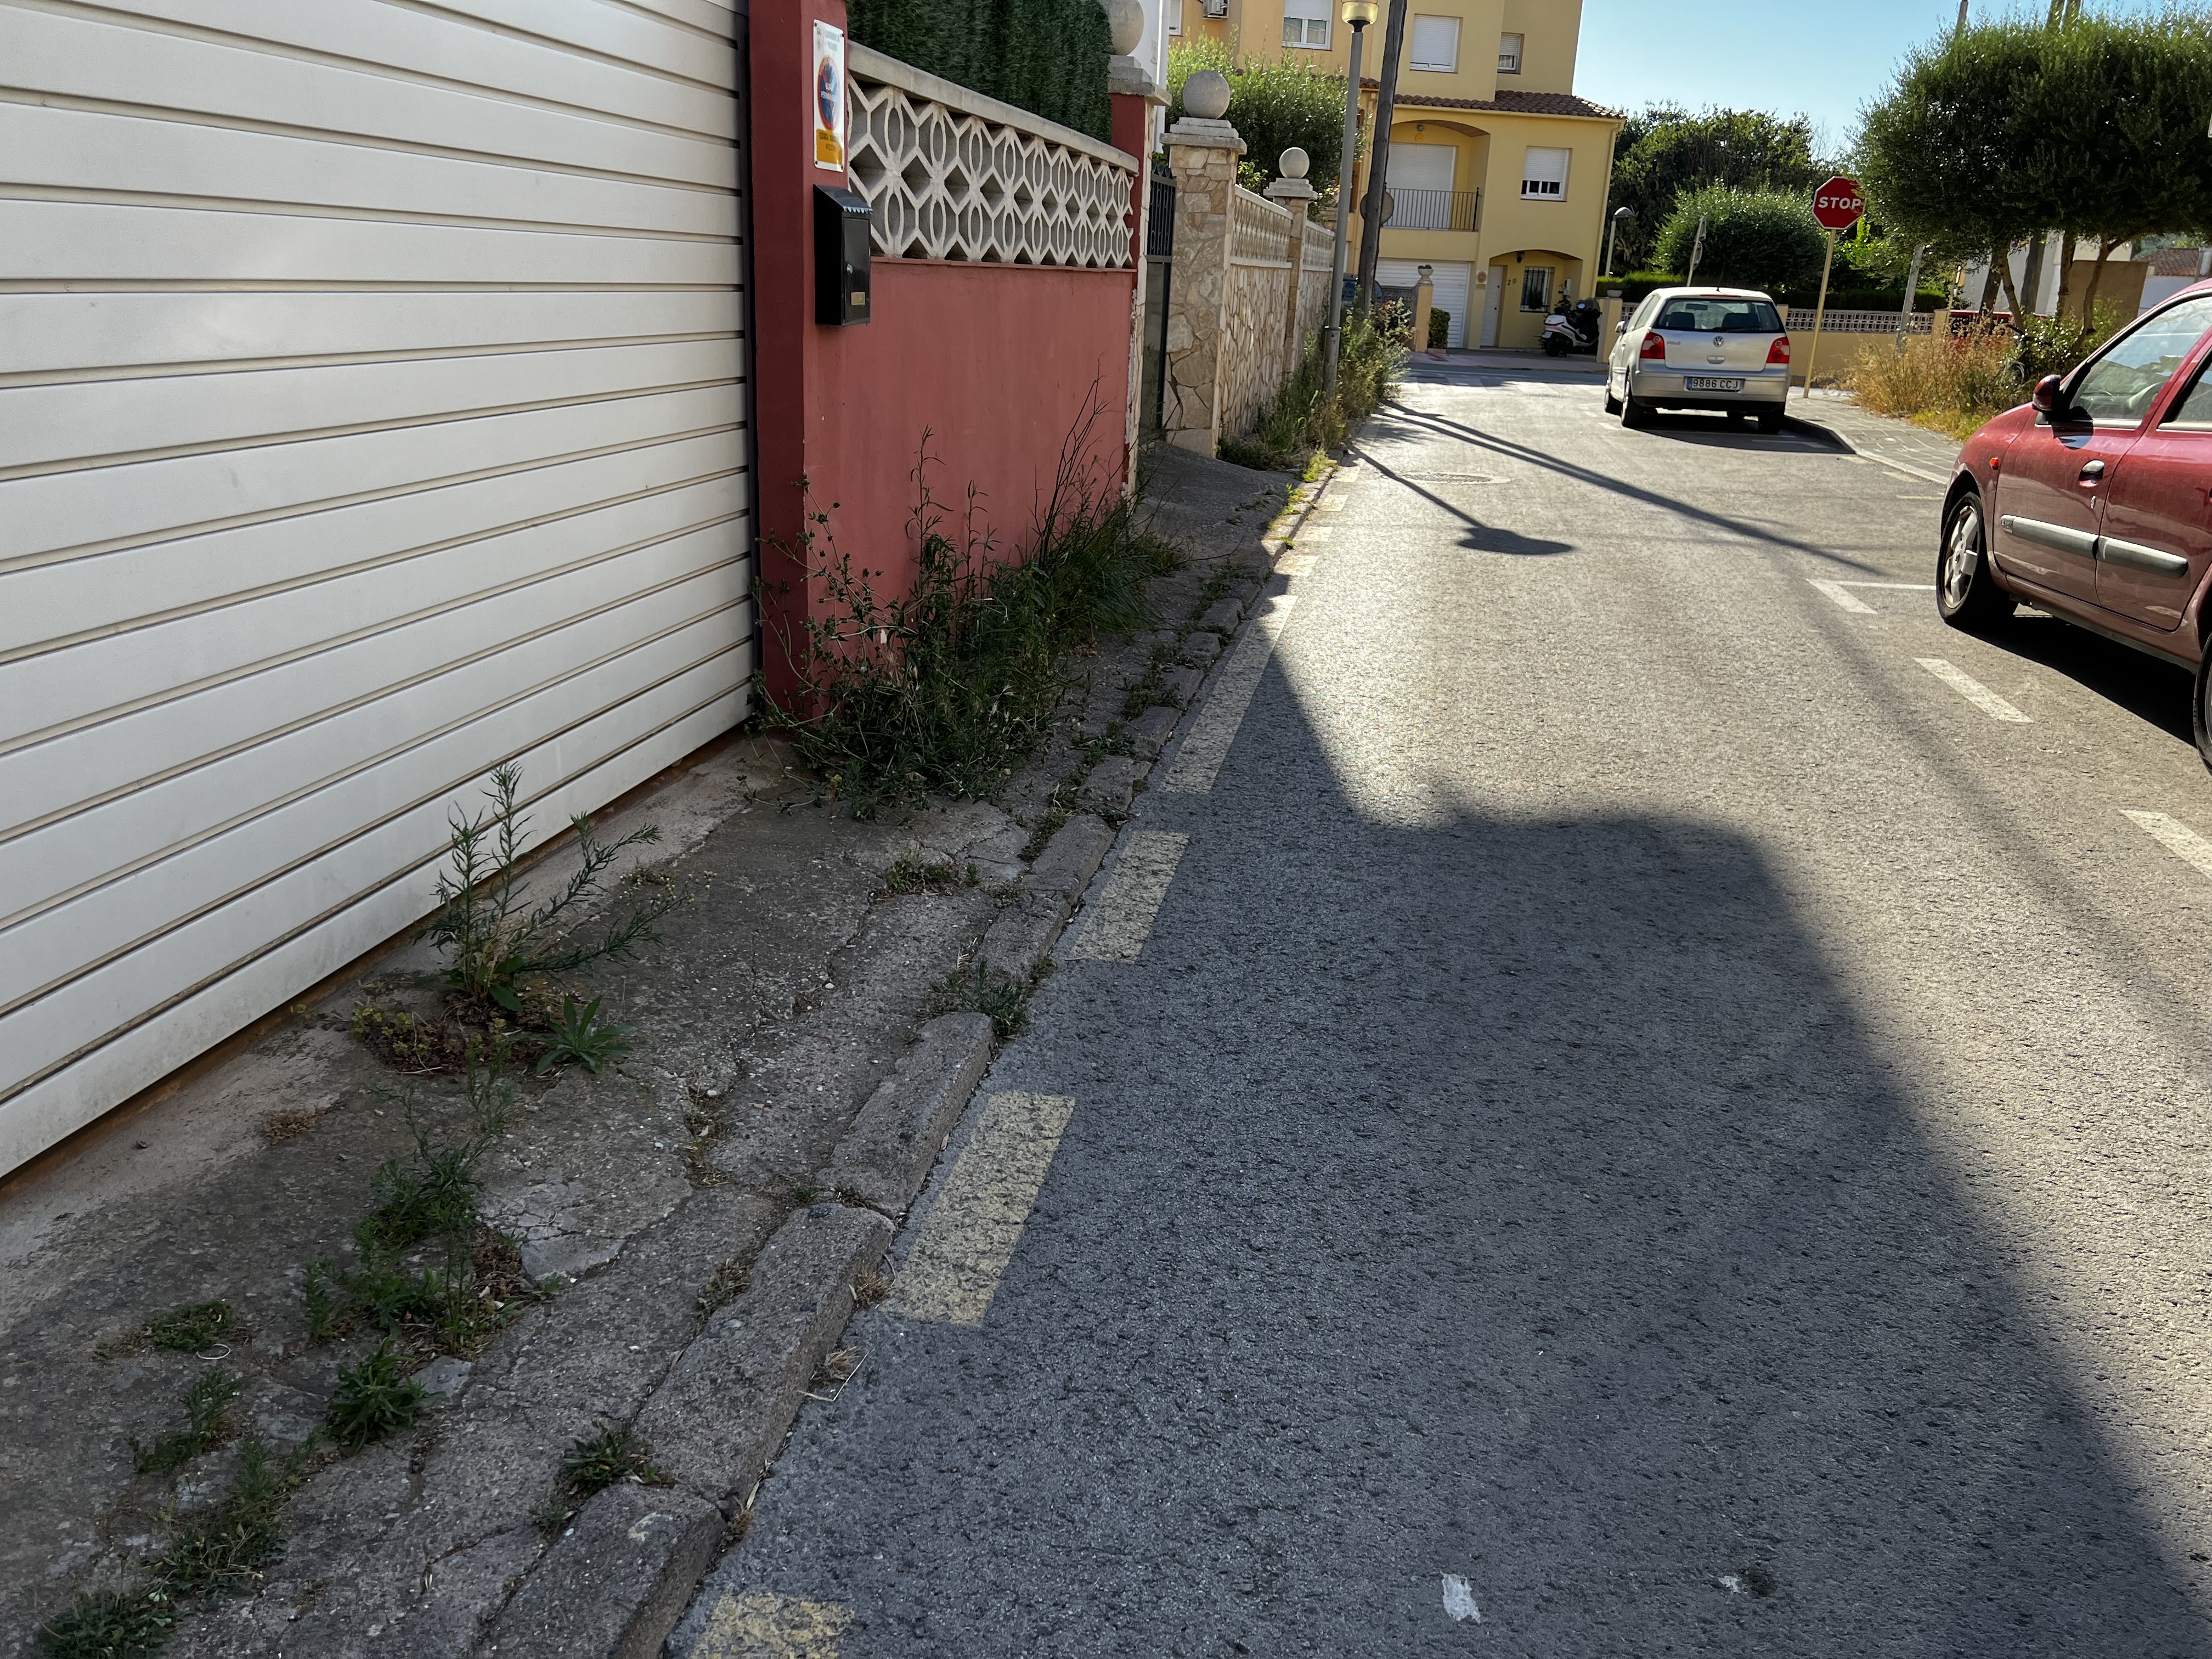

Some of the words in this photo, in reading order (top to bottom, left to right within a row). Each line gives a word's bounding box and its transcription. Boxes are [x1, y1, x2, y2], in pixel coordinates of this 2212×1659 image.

[1818, 196, 1861, 210] STOP
[1693, 379, 1717, 388] 9886
[1720, 380, 1738, 388] CCJ
